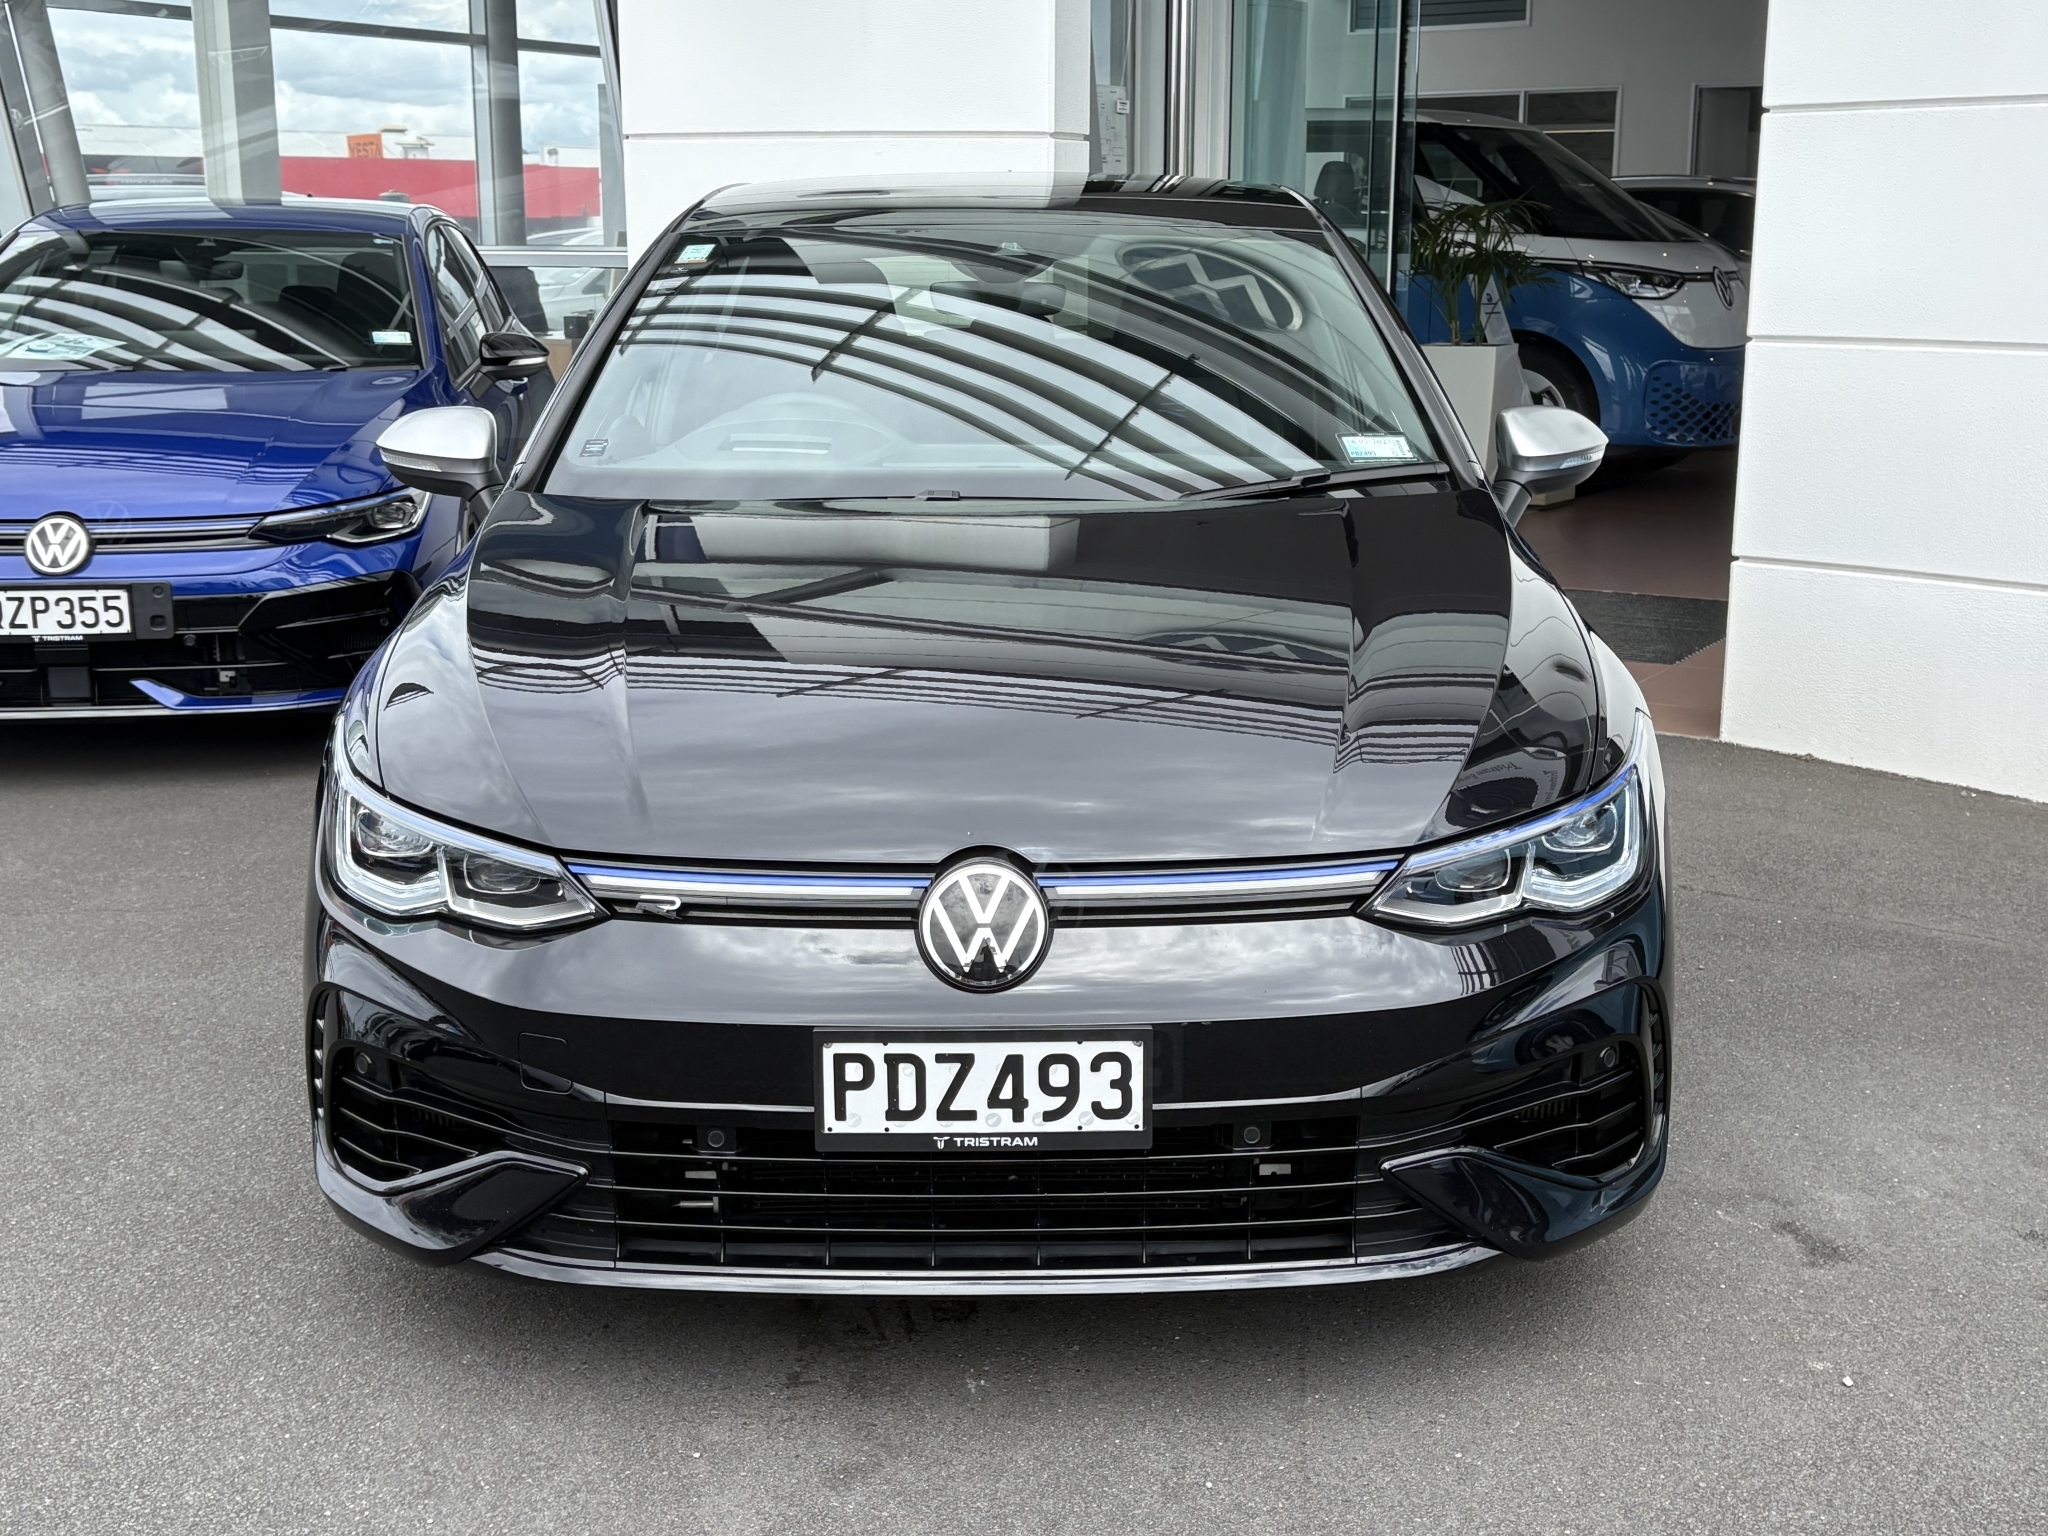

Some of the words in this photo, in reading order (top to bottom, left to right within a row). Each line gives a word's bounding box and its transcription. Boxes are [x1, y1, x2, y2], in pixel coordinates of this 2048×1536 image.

[29, 519, 86, 571] VW
[0, 595, 125, 630] ZP355
[42, 634, 84, 642] TRISTRAM
[925, 867, 1043, 979] VW
[832, 1051, 1133, 1124] PDZ493
[953, 1136, 1039, 1147] TRISTRAM
